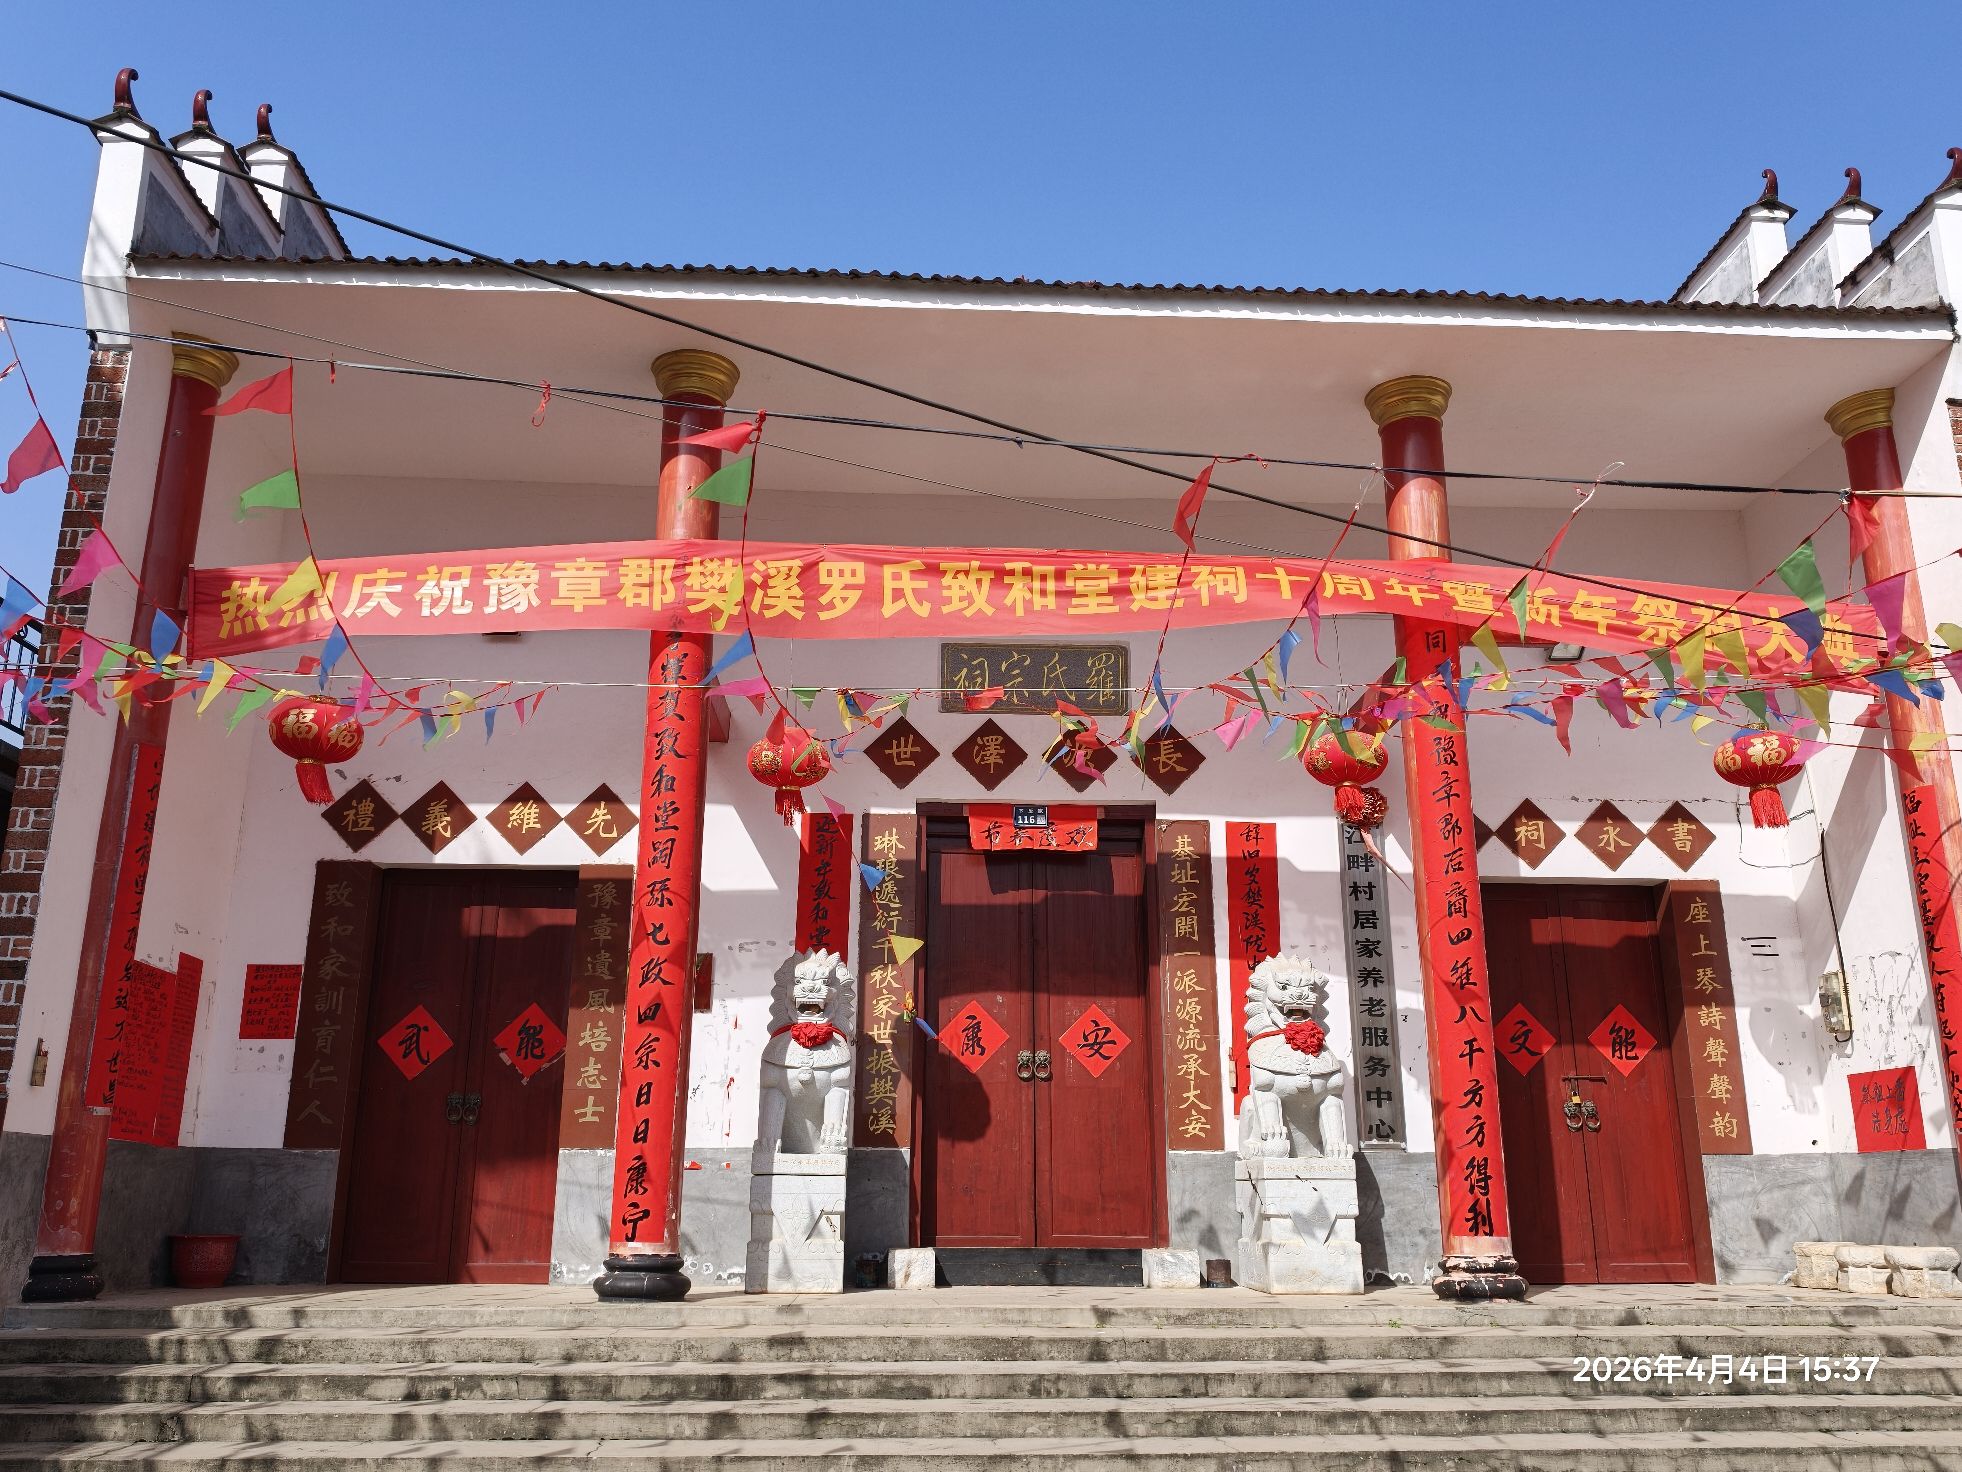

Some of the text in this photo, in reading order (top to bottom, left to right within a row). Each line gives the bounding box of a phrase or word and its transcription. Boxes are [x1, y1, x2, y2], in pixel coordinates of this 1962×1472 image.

[1345, 825, 1396, 1139] 江畔村居家养老服务中心
[1077, 1021, 1118, 1060] 安
[1509, 1019, 1541, 1057] 文
